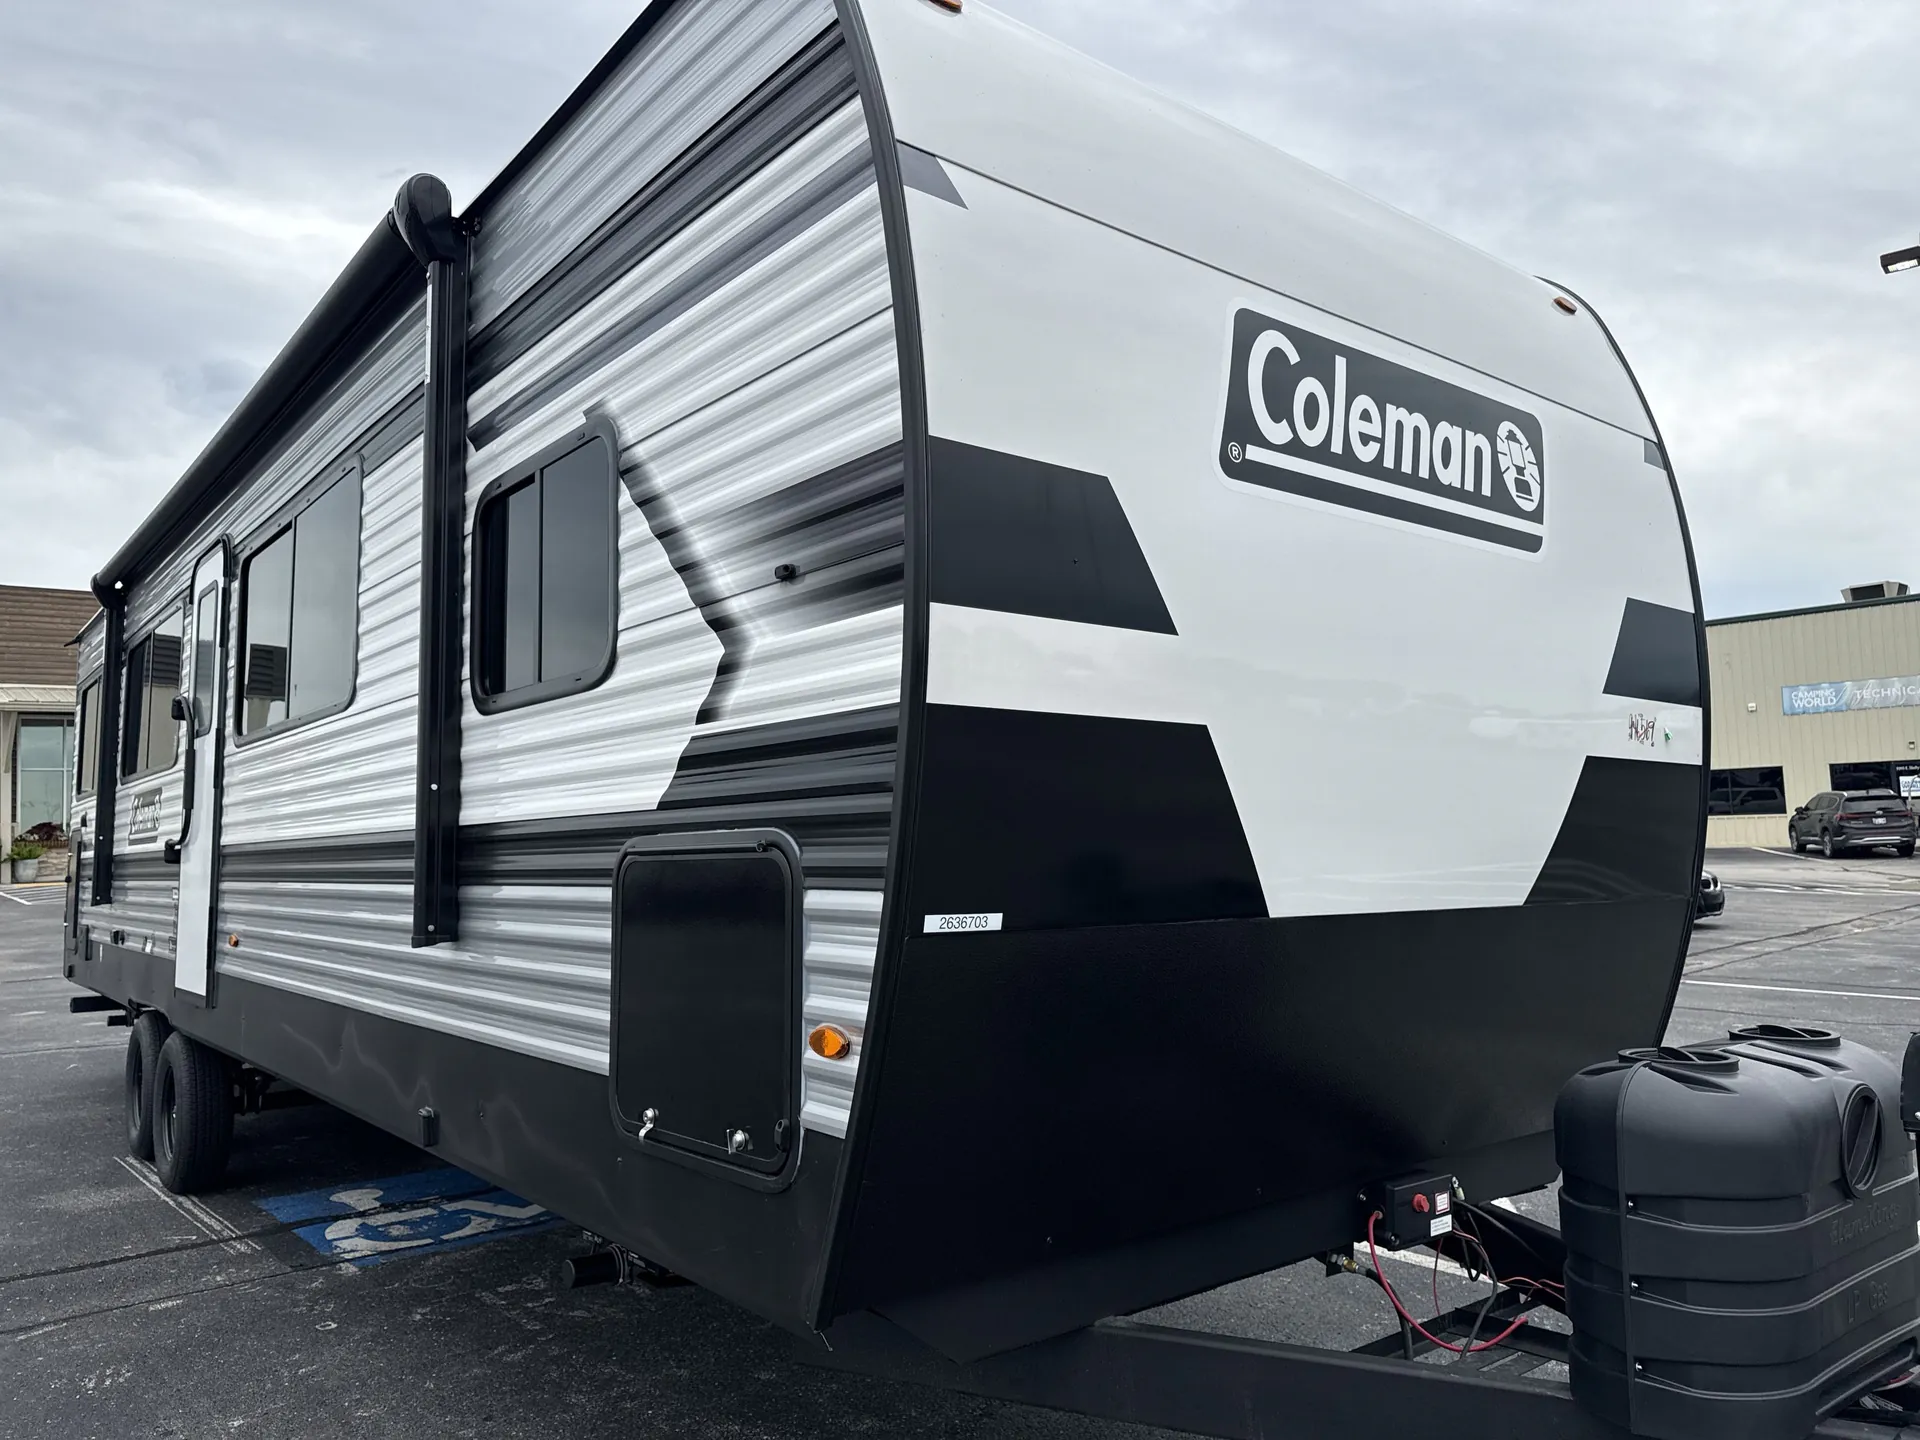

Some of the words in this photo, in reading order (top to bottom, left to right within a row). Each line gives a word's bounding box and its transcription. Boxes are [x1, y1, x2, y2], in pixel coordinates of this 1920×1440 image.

[1247, 329, 1492, 498] Coleman
[1791, 688, 1836, 699] CAMPING
[1792, 697, 1837, 708] WORLD
[939, 916, 988, 930] 2636703
